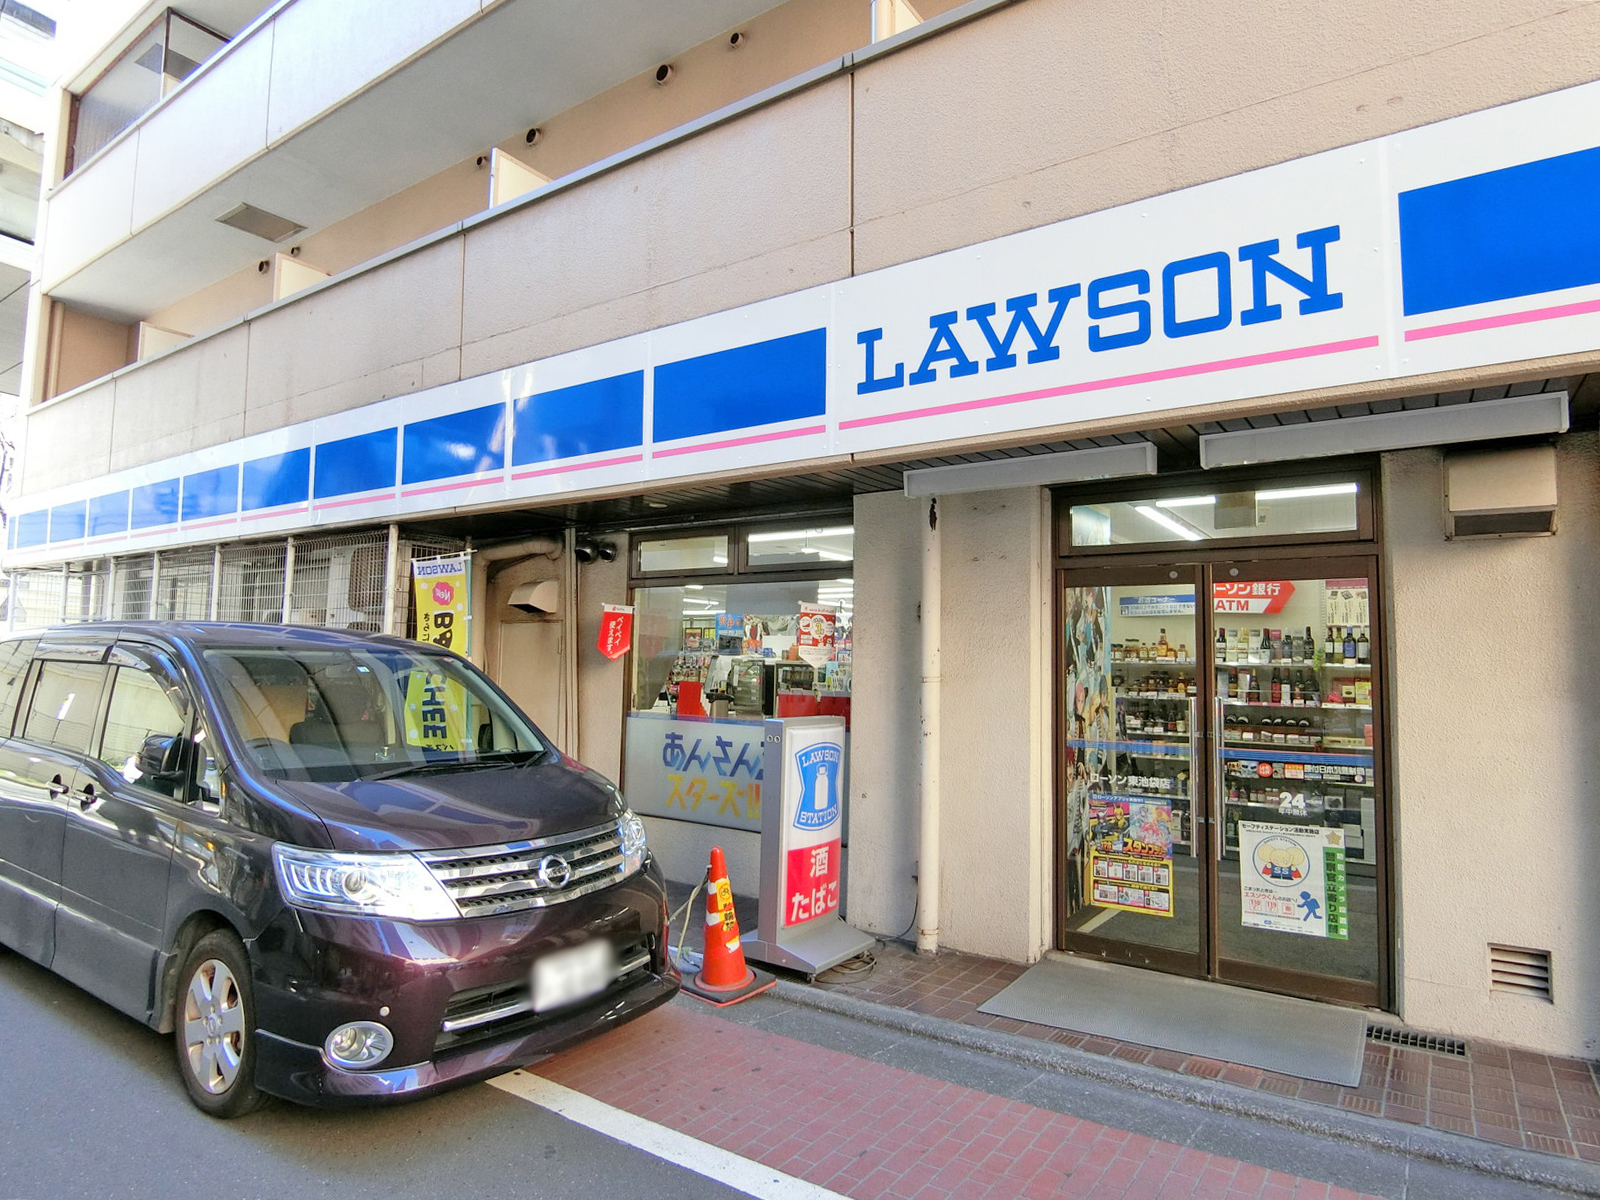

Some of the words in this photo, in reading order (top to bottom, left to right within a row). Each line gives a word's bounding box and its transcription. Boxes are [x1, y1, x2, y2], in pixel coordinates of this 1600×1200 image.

[857, 225, 1343, 395] LAWSON
[1214, 582, 1281, 596] ーソン銀行
[1215, 599, 1249, 611] ATM
[614, 616, 624, 646] ペイペイ
[663, 732, 764, 780] あんさん
[802, 750, 839, 768] LAWSON
[1279, 791, 1306, 809] 24
[801, 805, 837, 824] STATION
[810, 847, 829, 878] 酒
[791, 880, 837, 922] たばこ
